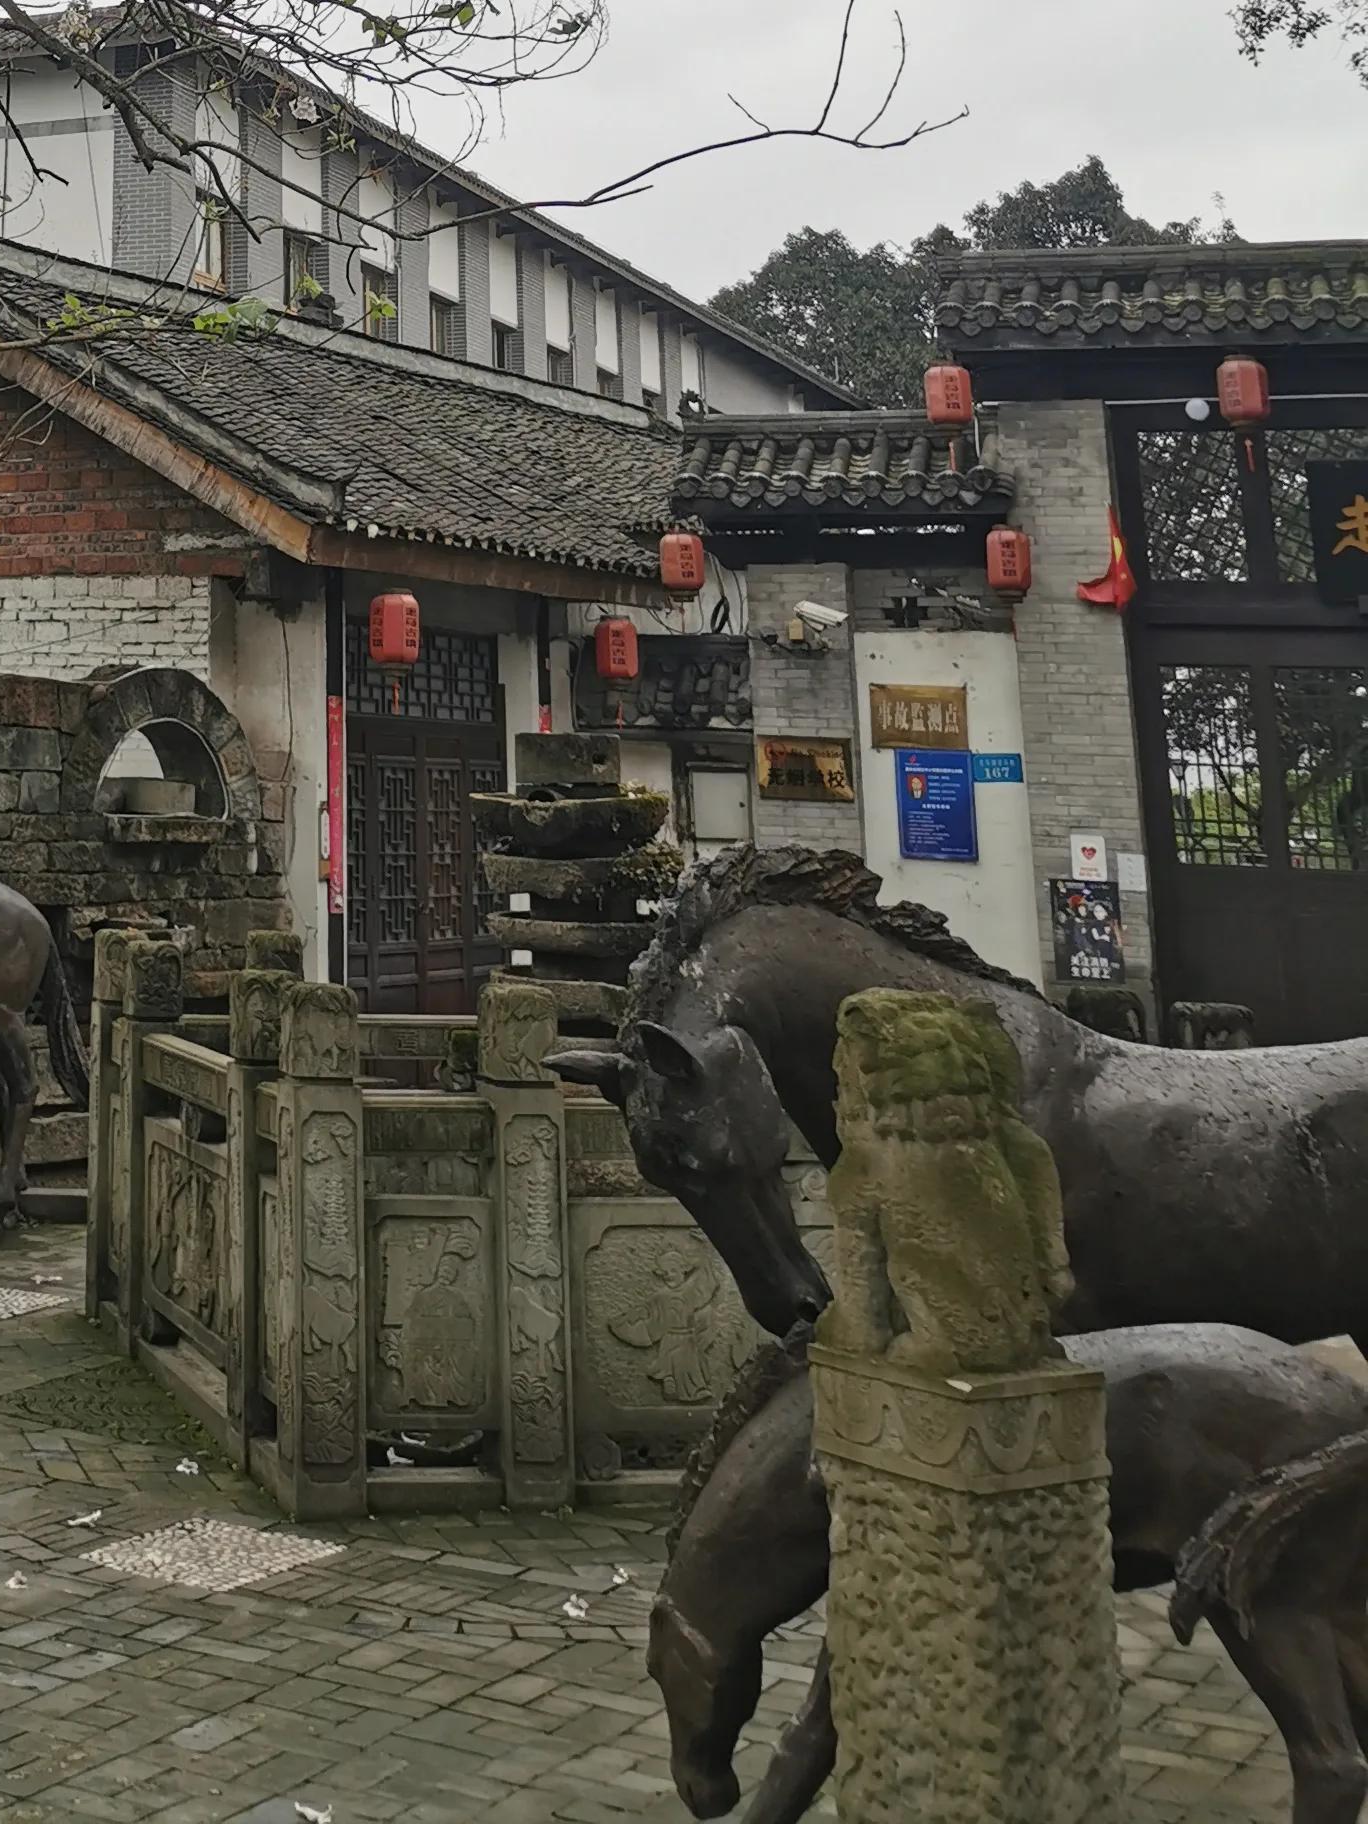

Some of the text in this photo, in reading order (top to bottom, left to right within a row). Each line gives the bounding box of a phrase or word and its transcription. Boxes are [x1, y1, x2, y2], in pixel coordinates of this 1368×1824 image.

[680, 545, 694, 578] 走马古镇
[1001, 541, 1017, 577] 走马古镇
[405, 607, 417, 648] 走马古镇
[611, 629, 626, 665] 走马古镇
[879, 699, 959, 734] 事故监测点
[984, 767, 1010, 779] 167
